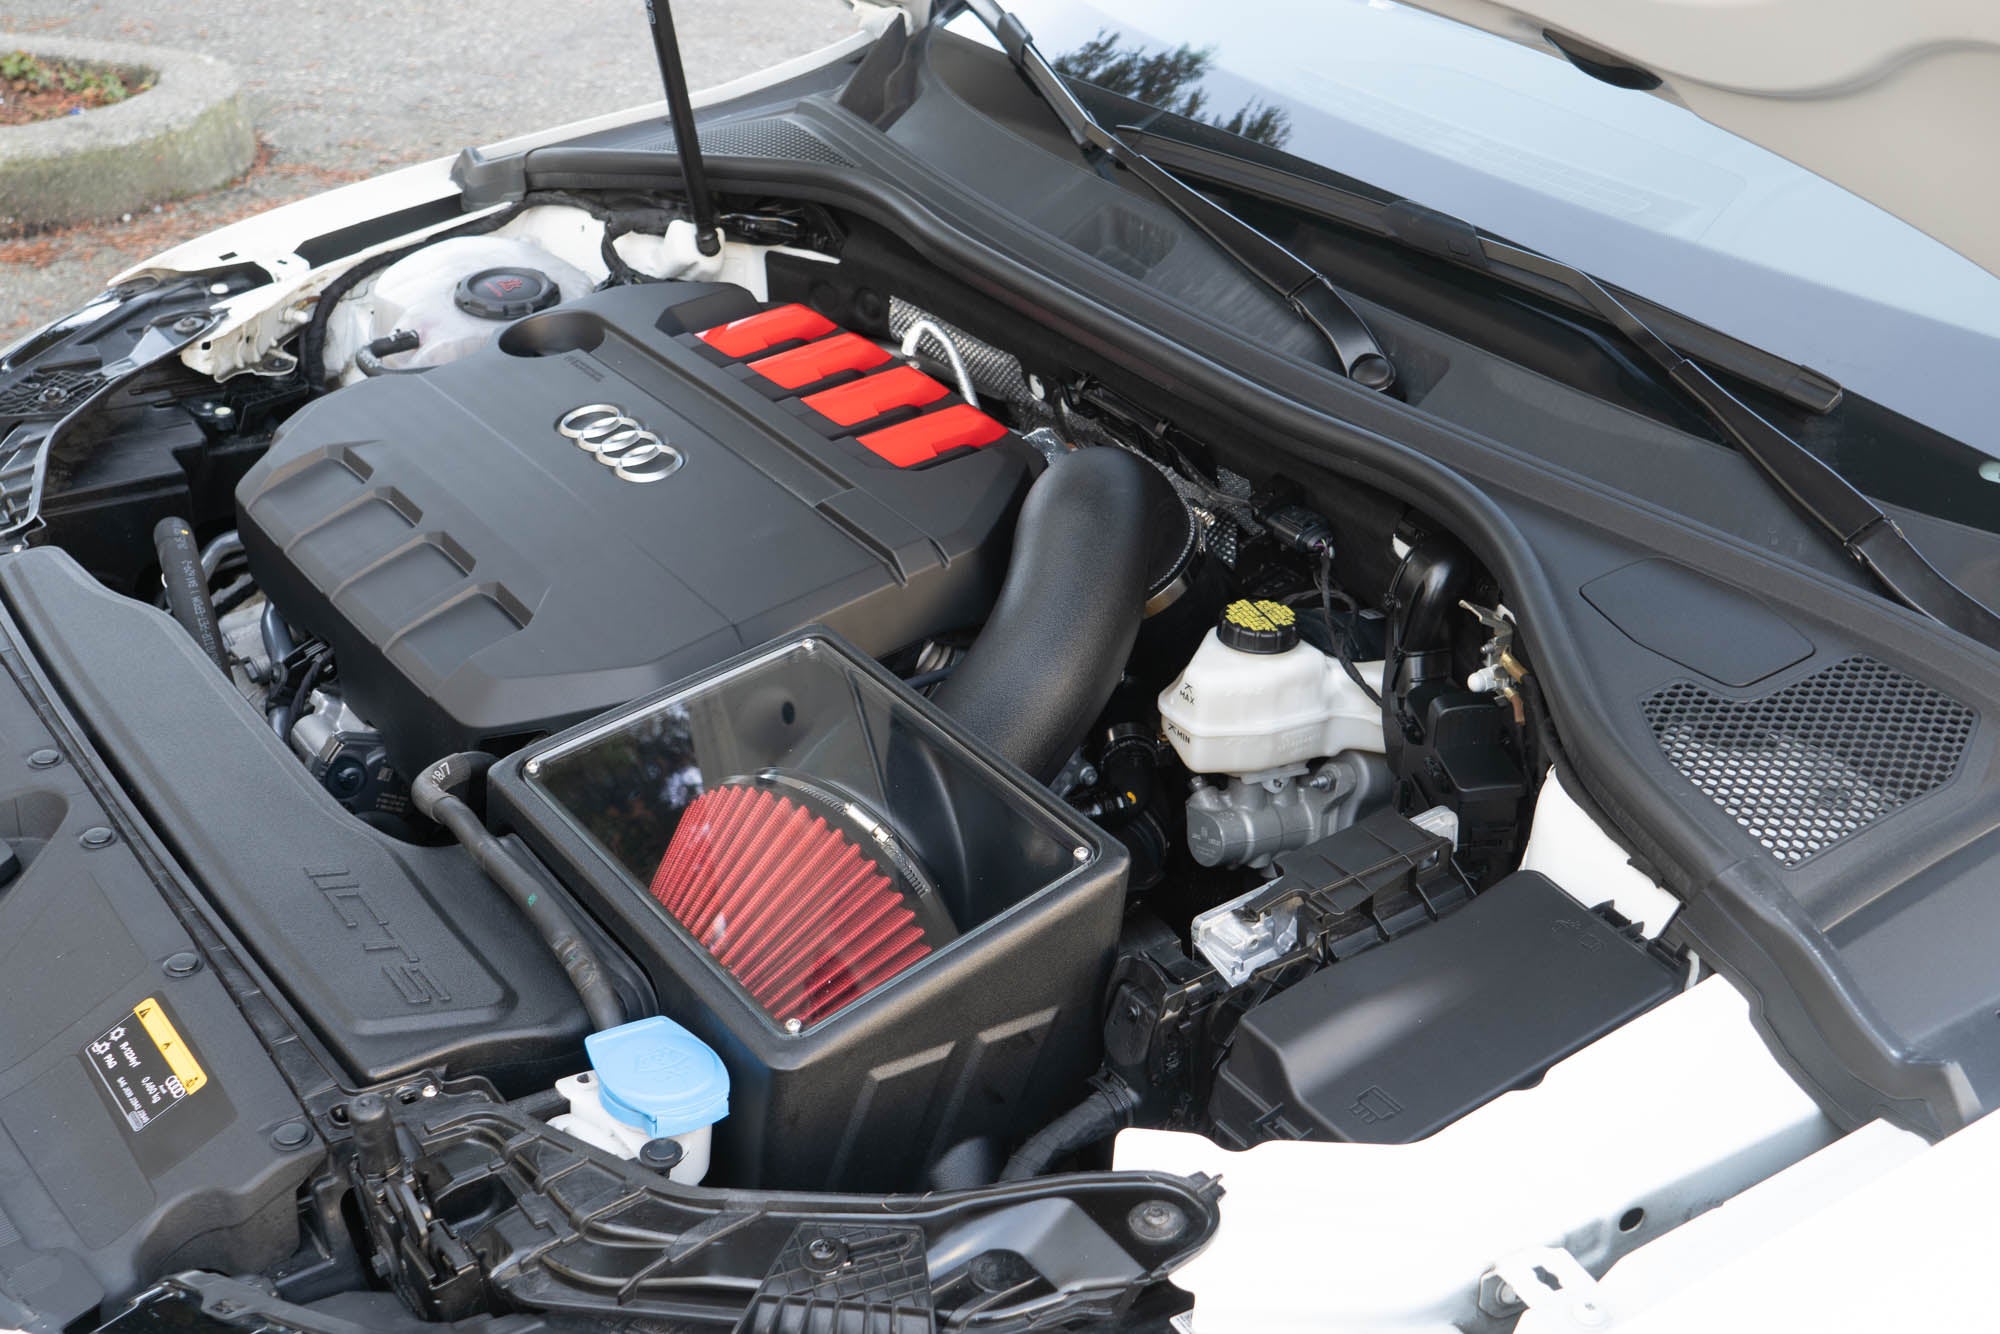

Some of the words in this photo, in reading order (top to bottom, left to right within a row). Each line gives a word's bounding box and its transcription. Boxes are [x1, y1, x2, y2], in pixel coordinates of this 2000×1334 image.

[1179, 690, 1195, 705] MAX
[1176, 730, 1191, 744] MIN
[103, 1053, 118, 1069] PAG
